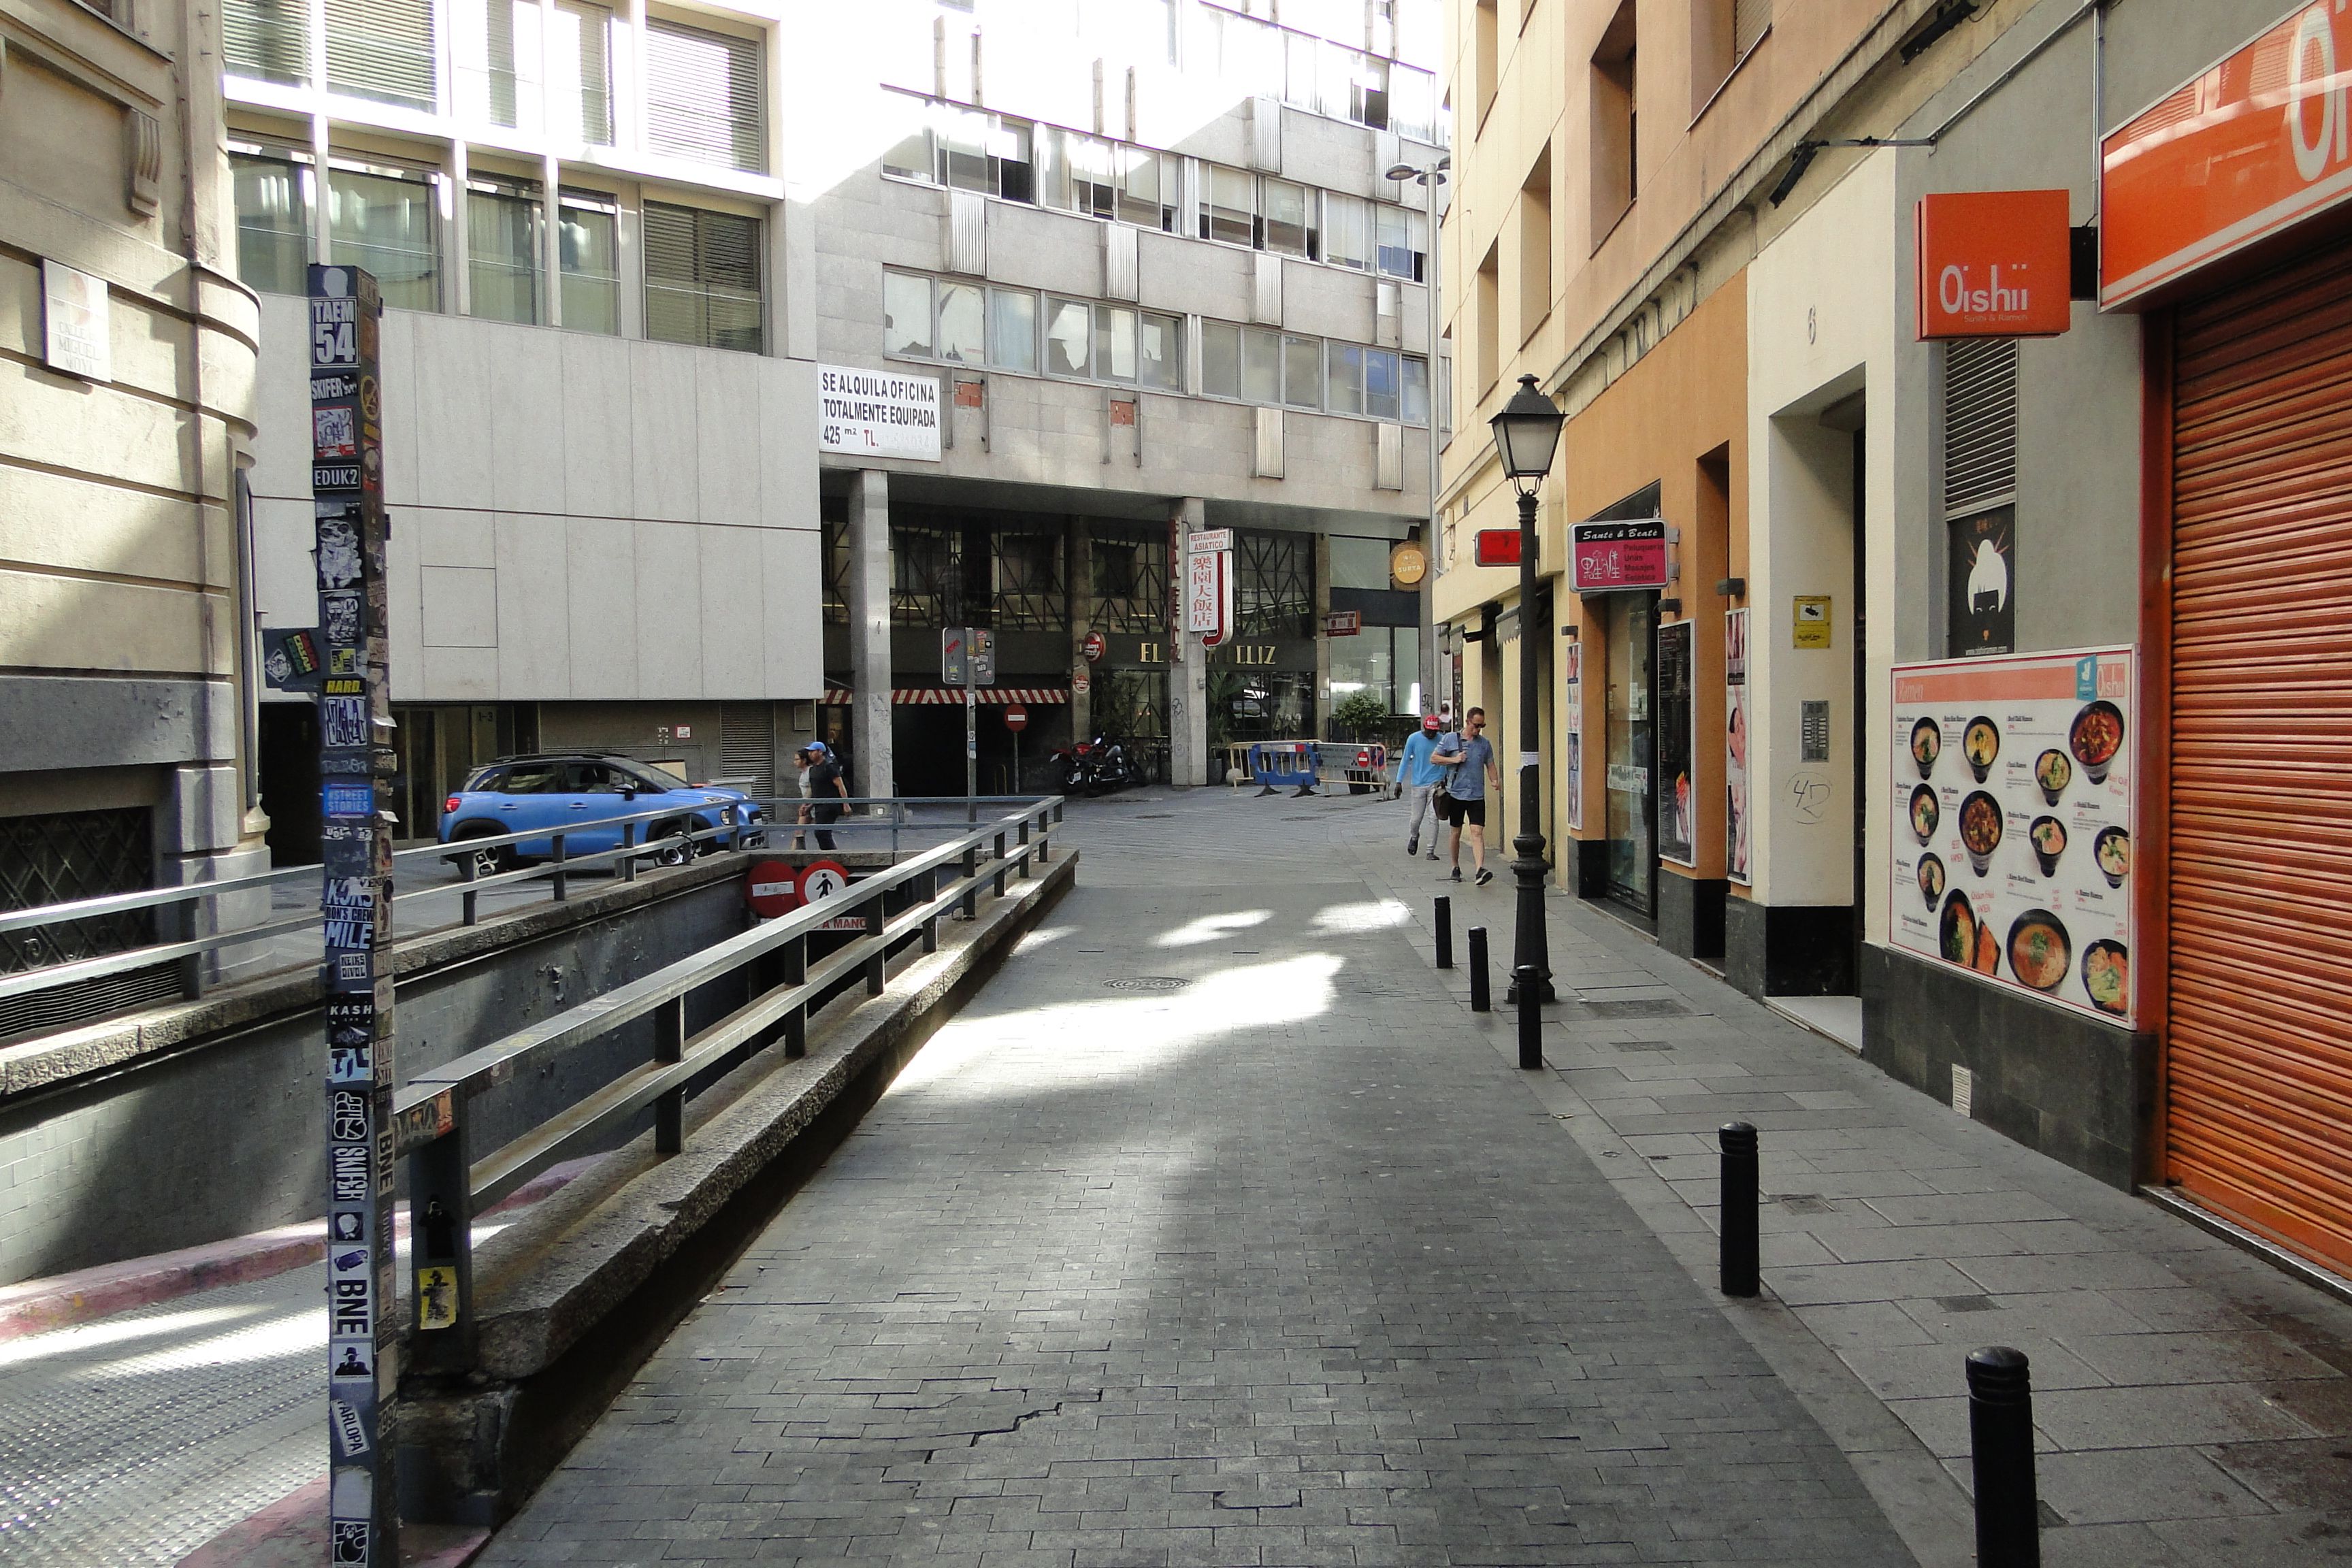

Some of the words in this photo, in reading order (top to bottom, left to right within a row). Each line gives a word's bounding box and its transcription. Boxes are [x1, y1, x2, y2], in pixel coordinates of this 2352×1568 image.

[314, 301, 354, 323] TAEM
[59, 334, 101, 361] MIGUEL
[315, 323, 355, 363] 54
[66, 356, 94, 376] MOYA
[311, 377, 344, 399] SKIFER
[822, 372, 836, 392] SE
[839, 374, 888, 398] ALQUILA
[890, 380, 935, 404] OFICINA
[823, 398, 887, 424] TOTALMENTE
[889, 406, 936, 429] EQUIPADA
[823, 425, 840, 444] 425
[314, 468, 358, 486] EDUK2
[1190, 531, 1227, 542] RESTAURANTE
[1617, 529, 1624, 538] &
[1194, 541, 1224, 551] ASIATICO
[1140, 642, 1164, 664] EL
[328, 801, 369, 813] STORIES
[325, 921, 374, 949] MILE
[330, 1004, 373, 1016] KASH
[379, 1134, 394, 1194] BNE
[336, 1279, 368, 1335] BNE
